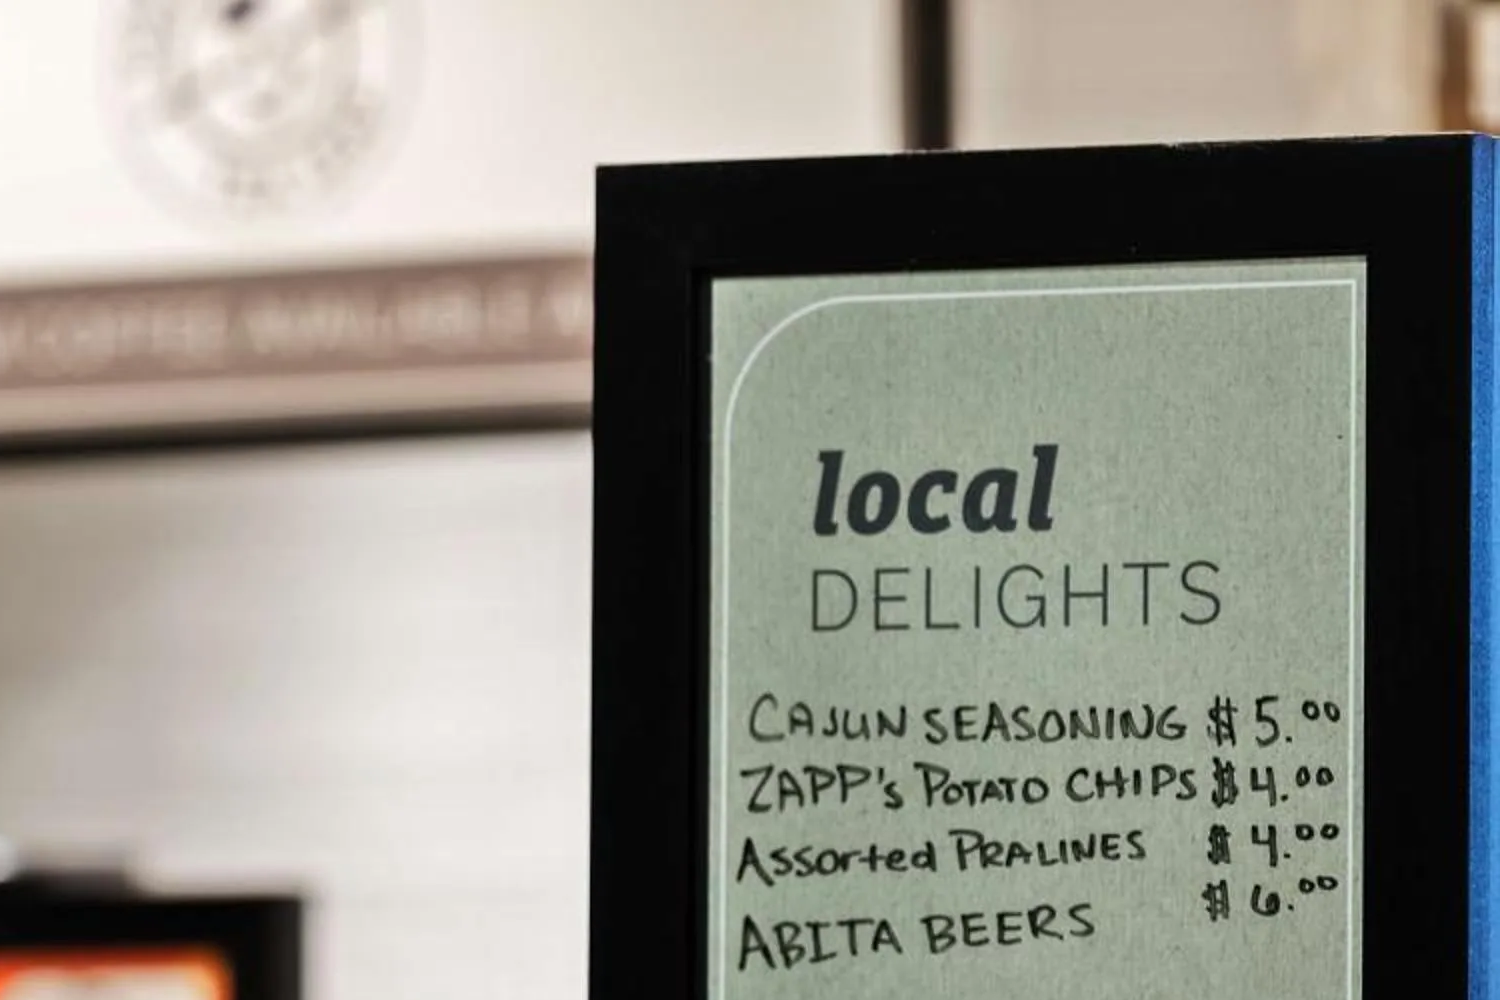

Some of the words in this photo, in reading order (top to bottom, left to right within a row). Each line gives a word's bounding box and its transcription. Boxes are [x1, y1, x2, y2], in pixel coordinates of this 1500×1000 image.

[812, 443, 1059, 536] local
[810, 560, 1222, 632] DELIGHTS
[748, 692, 908, 744] CAJUN
[923, 703, 1188, 745] SEASONING
[740, 763, 904, 814] ZAPP's
[1064, 763, 1198, 802] CHIPS
[735, 836, 937, 887] Assorted
[948, 828, 1146, 871] PRALINES
[737, 912, 904, 972] ABITA
[920, 902, 1096, 954] BEERS
